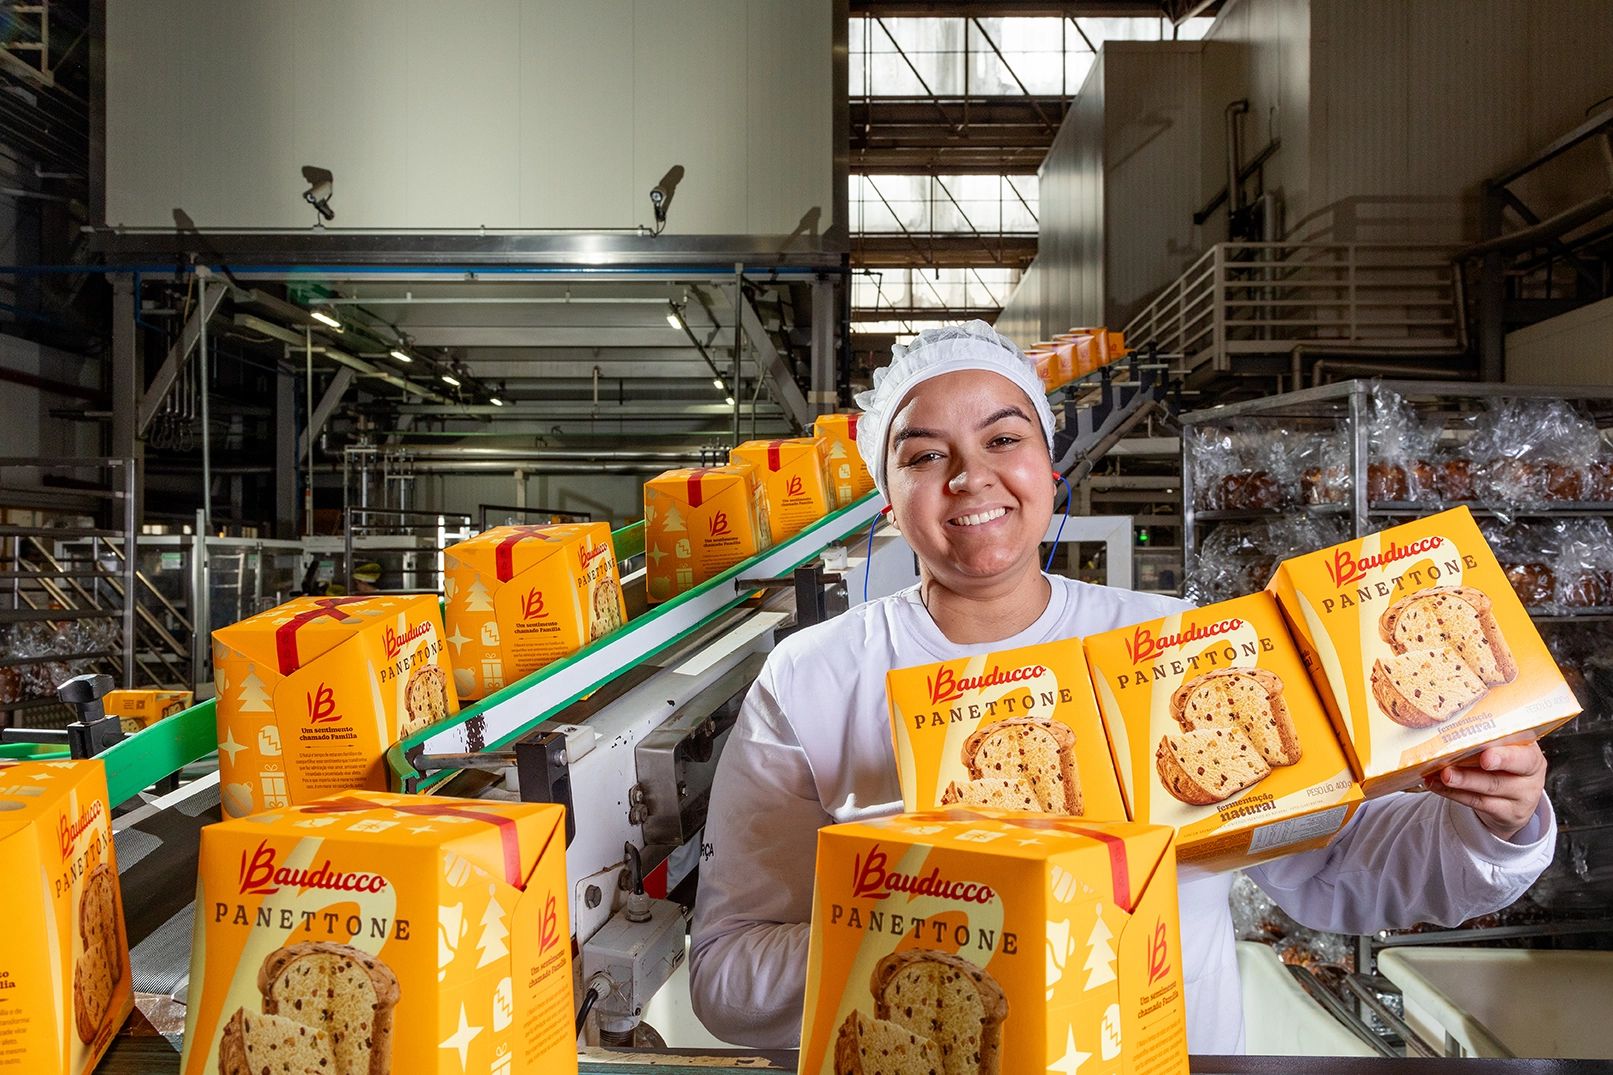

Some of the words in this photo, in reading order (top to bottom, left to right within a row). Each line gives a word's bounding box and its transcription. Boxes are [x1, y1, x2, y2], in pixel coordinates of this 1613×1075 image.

[577, 557, 616, 588] PANETTONE
[1322, 554, 1478, 614] PANETTONE
[1324, 536, 1444, 589] Bauducco
[381, 639, 443, 683] PANETTONE
[382, 621, 432, 661] Bauducco
[1117, 637, 1275, 689] PANETTONE
[1125, 618, 1244, 666] Bauducco
[927, 664, 1047, 706] Bauducco
[914, 688, 1073, 730] PANETTONE
[299, 733, 330, 741] chamado
[1442, 719, 1497, 744] natural
[1216, 792, 1274, 814] fermentação
[1219, 799, 1277, 823] natural
[56, 800, 102, 865] Bauducco
[55, 825, 112, 898] PANETTONE
[239, 838, 388, 895] Bauducco
[853, 843, 995, 905] Bauducco
[214, 902, 410, 940] PANETTONE
[831, 904, 1018, 955] PANETTONE
